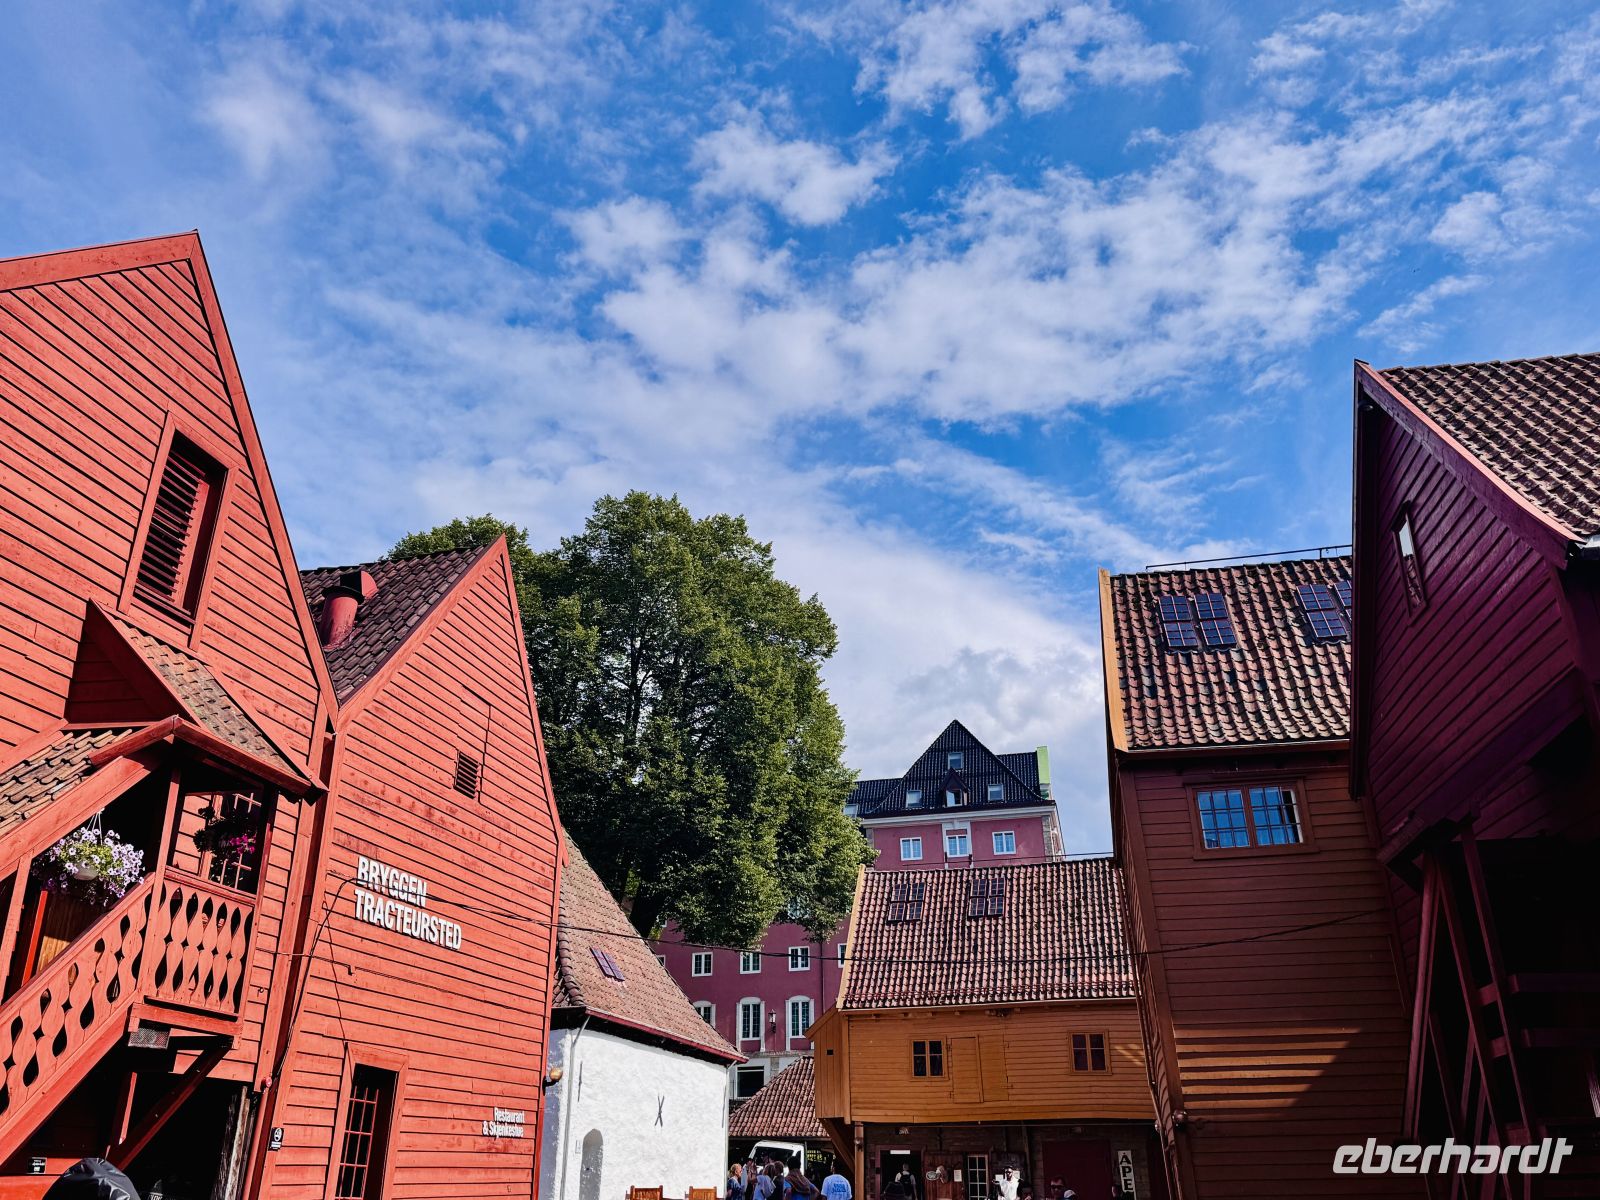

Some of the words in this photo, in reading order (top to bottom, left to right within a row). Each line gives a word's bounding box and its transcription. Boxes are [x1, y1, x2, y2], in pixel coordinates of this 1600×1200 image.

[357, 855, 427, 907] BRYGGEN
[354, 889, 462, 950] TRACTEURSTED
[482, 1120, 489, 1136] &
[494, 1107, 525, 1123] Restaurant
[1120, 1152, 1134, 1190] ÅPE
